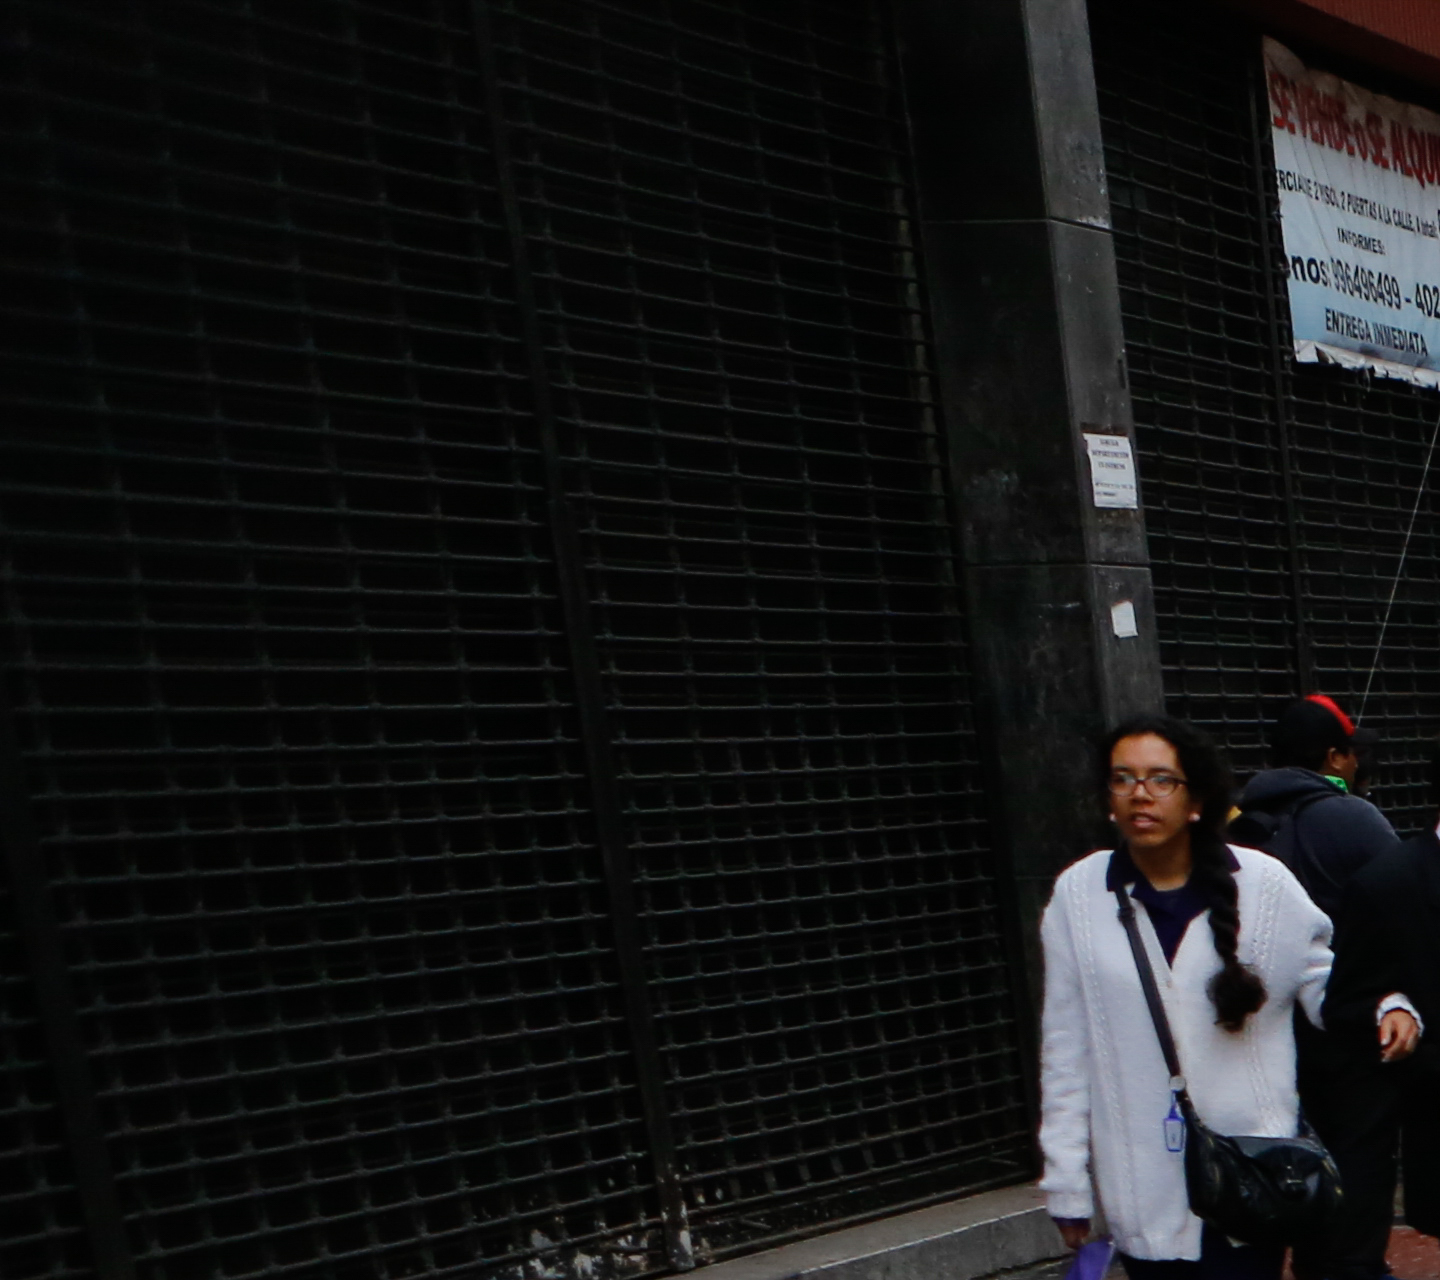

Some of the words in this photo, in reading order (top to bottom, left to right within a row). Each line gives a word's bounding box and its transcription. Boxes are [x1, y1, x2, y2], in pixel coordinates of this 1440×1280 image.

[1269, 72, 1296, 136] SE
[1365, 111, 1390, 170] SE
[1337, 227, 1387, 256] INFORMES:
[1325, 307, 1373, 344] ENTREGA
[1372, 319, 1429, 357] INMEDIATA
